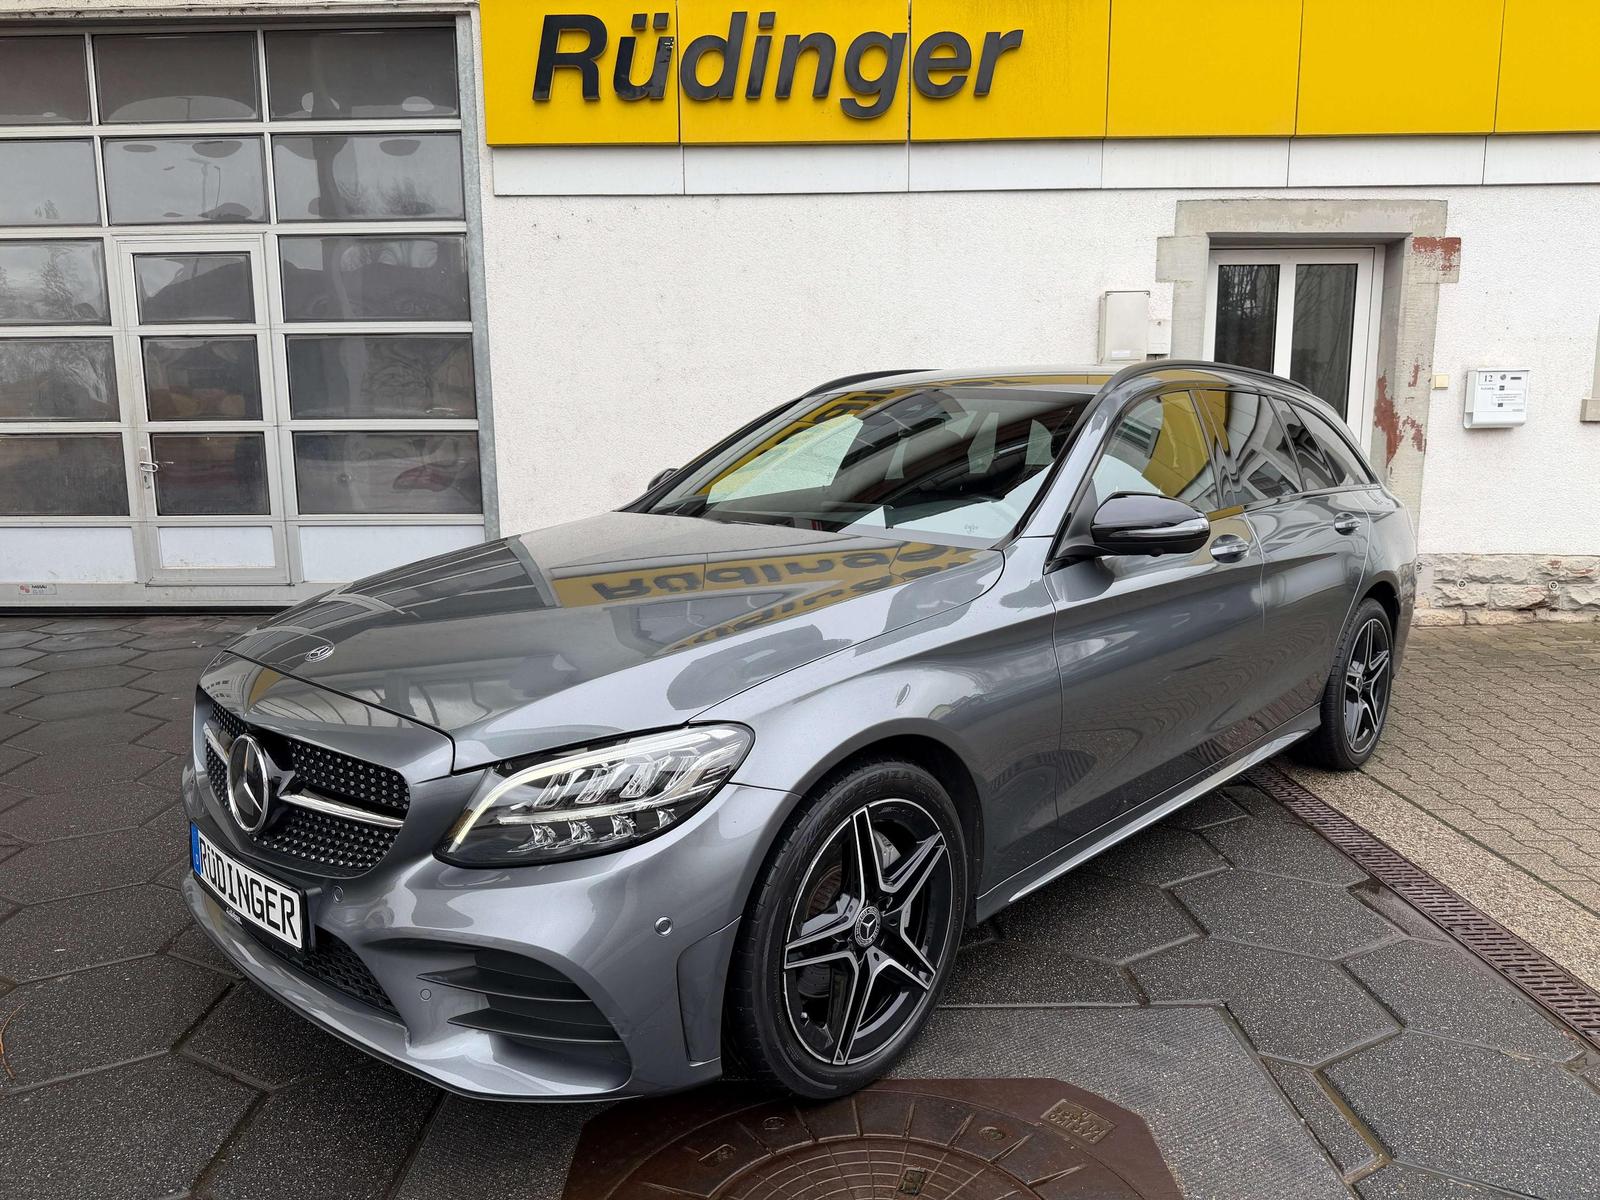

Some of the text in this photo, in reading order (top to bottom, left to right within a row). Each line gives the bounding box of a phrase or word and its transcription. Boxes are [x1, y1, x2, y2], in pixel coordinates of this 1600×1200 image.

[532, 11, 1024, 120] Rüdinger
[1484, 374, 1493, 382] 12
[199, 836, 298, 941] RÜDINGER
